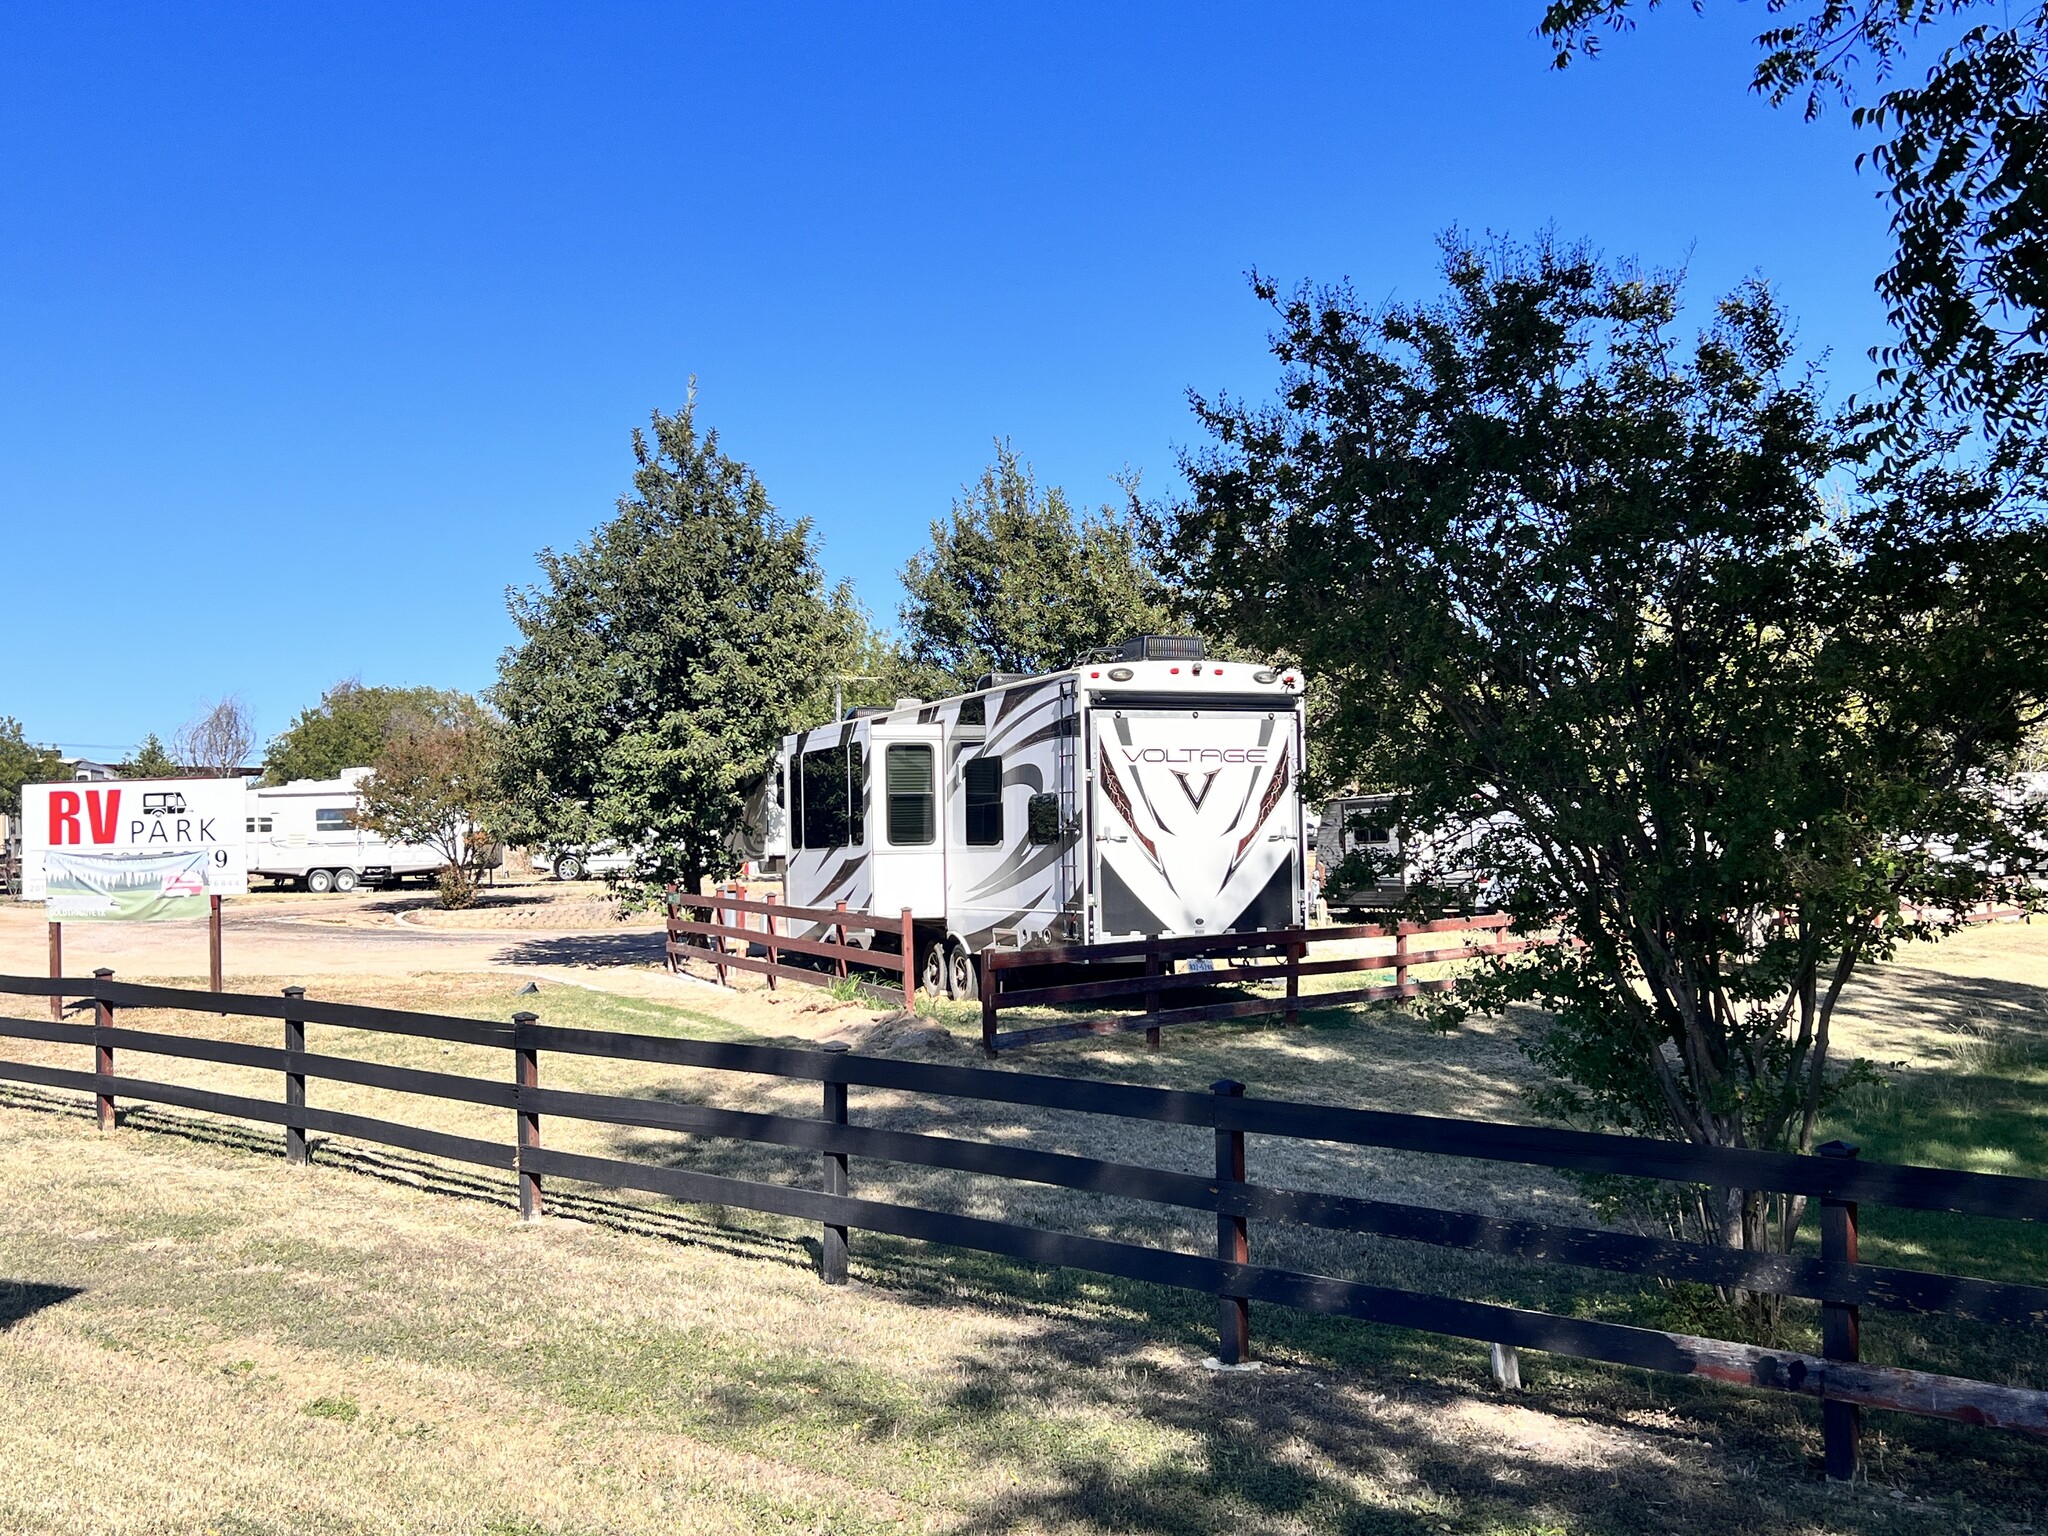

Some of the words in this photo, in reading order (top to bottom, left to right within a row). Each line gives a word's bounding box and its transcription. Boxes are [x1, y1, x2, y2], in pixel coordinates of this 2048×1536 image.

[1121, 748, 1268, 763] VOLTAGE
[49, 789, 121, 845] RV
[131, 818, 216, 844] PARK
